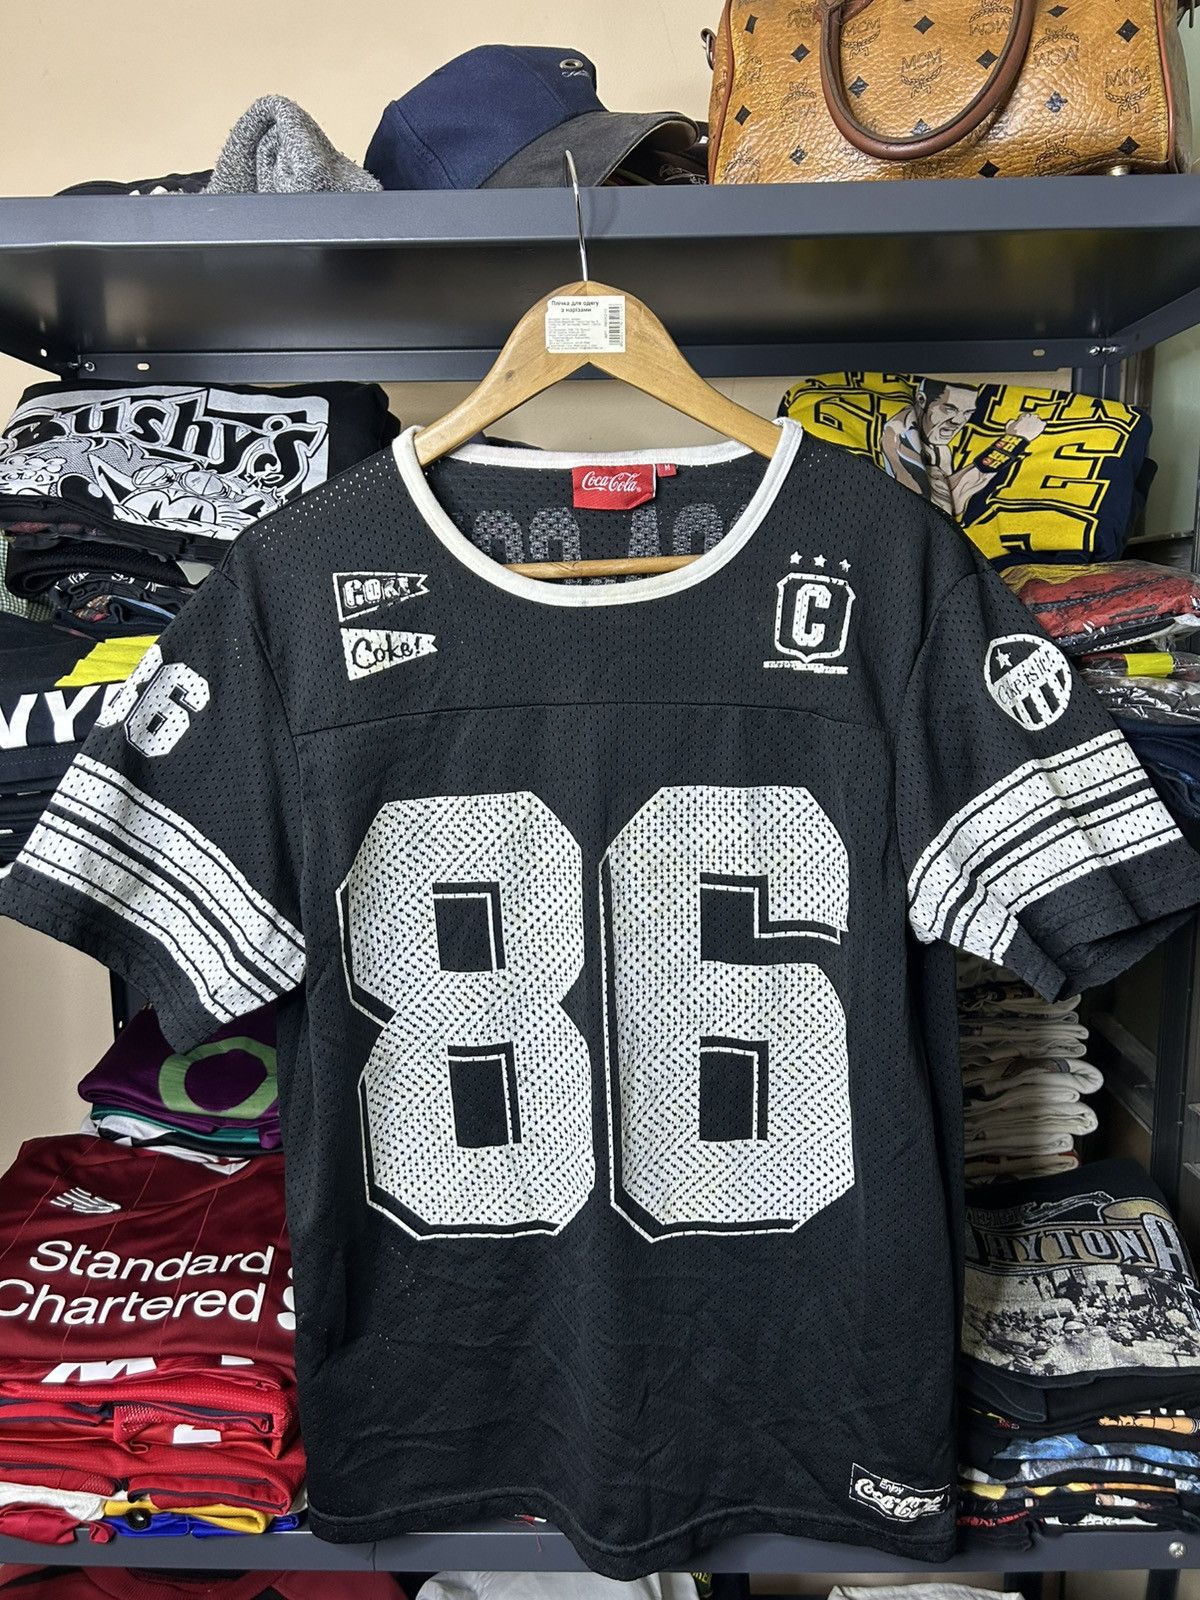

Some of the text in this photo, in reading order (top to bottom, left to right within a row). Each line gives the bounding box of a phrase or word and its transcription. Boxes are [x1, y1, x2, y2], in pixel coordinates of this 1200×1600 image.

[843, 18, 881, 36] MCM
[901, 47, 942, 72] MCM
[1105, 65, 1151, 88] MCM
[792, 583, 832, 647] C
[351, 633, 422, 669] Coke!
[336, 786, 855, 1243] 86
[29, 1240, 275, 1282] Standard
[0, 1278, 266, 1326] Chartered
